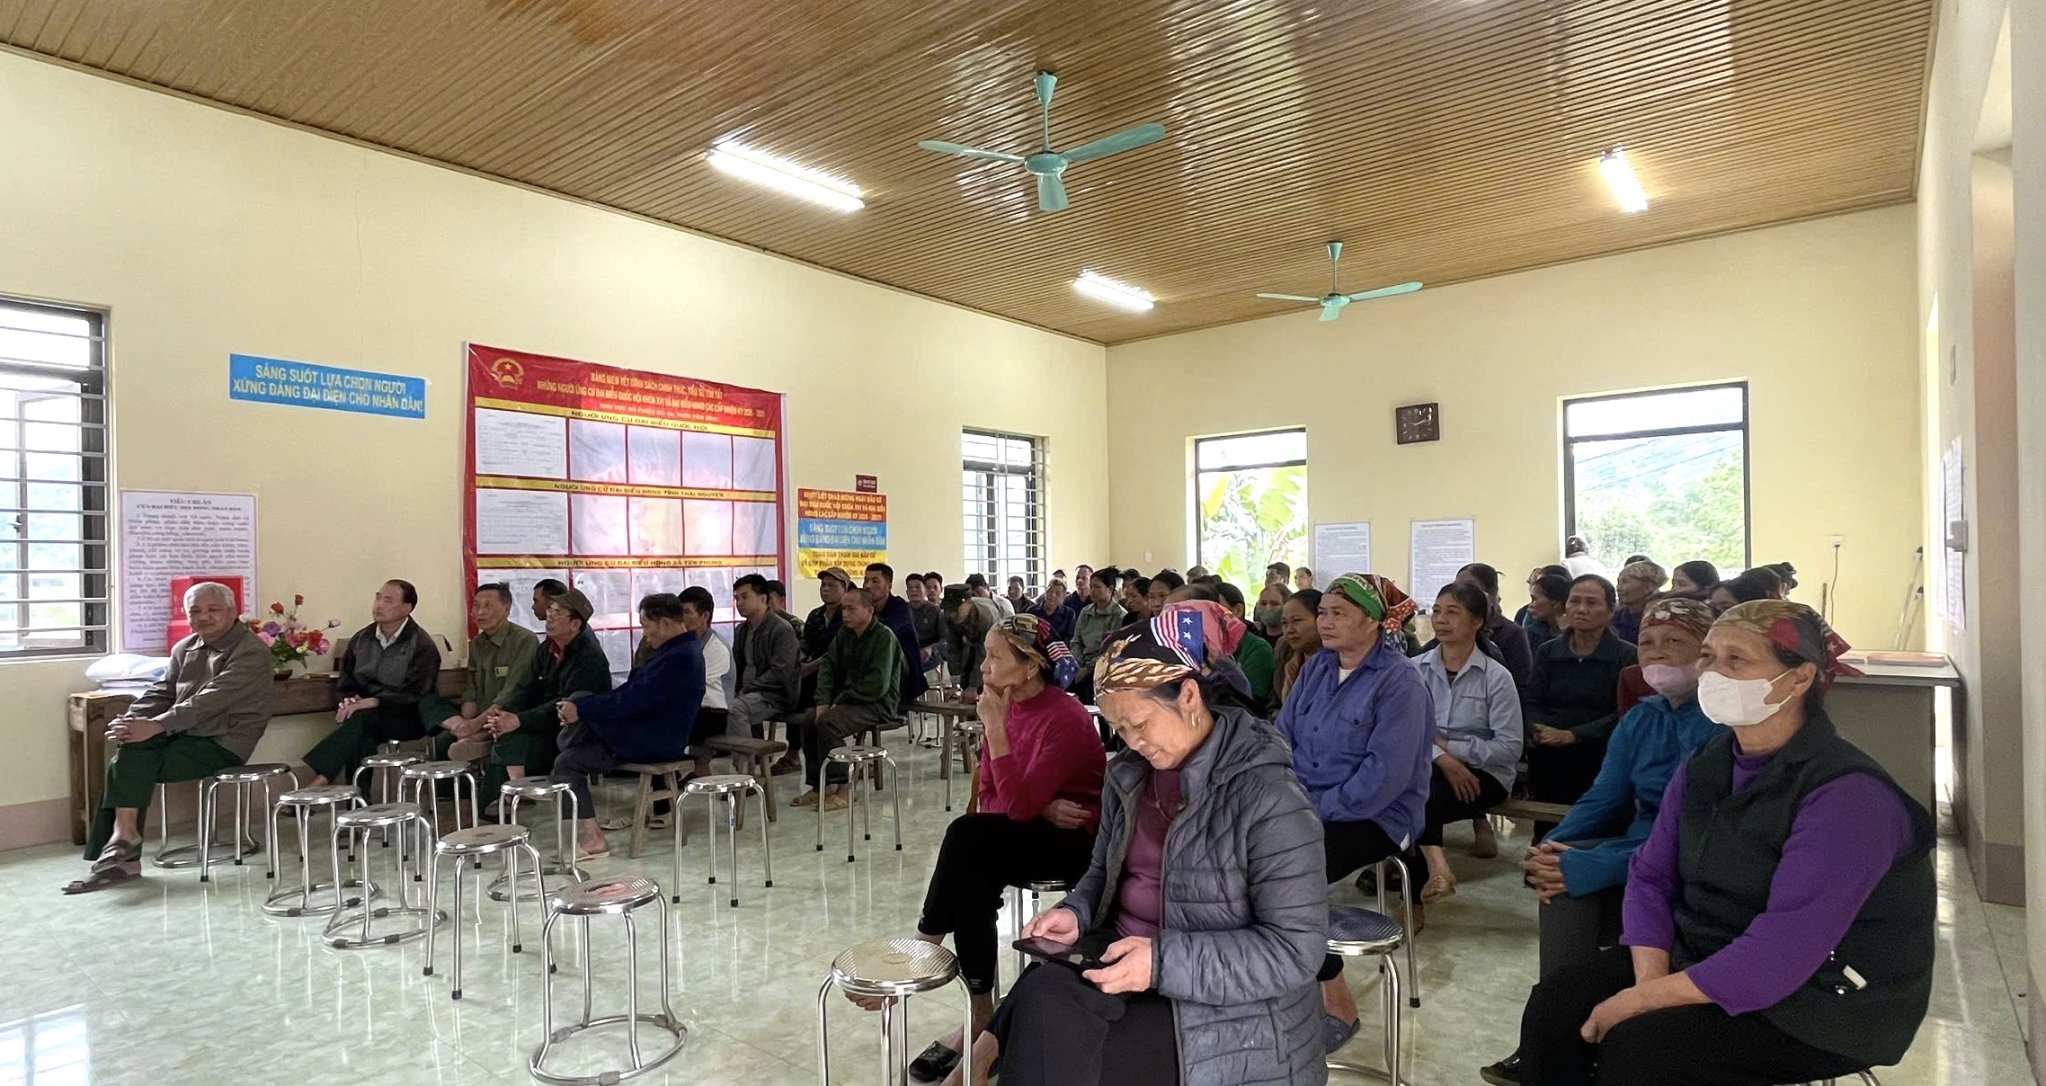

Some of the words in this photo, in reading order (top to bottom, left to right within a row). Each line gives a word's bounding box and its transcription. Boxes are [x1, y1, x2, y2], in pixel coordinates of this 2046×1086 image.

[233, 377, 266, 395] XỨNG
[269, 380, 300, 398] ĐÁNG
[303, 386, 321, 403] ĐẠI
[323, 389, 346, 406] DIỆN
[349, 391, 370, 406] CHO
[372, 393, 399, 409] NHÂN
[255, 362, 287, 381] SÁNG
[289, 367, 318, 384] SUỐT
[320, 372, 342, 389] LỰA
[344, 375, 371, 392] CHỌN
[374, 378, 406, 395] NGƯỜI
